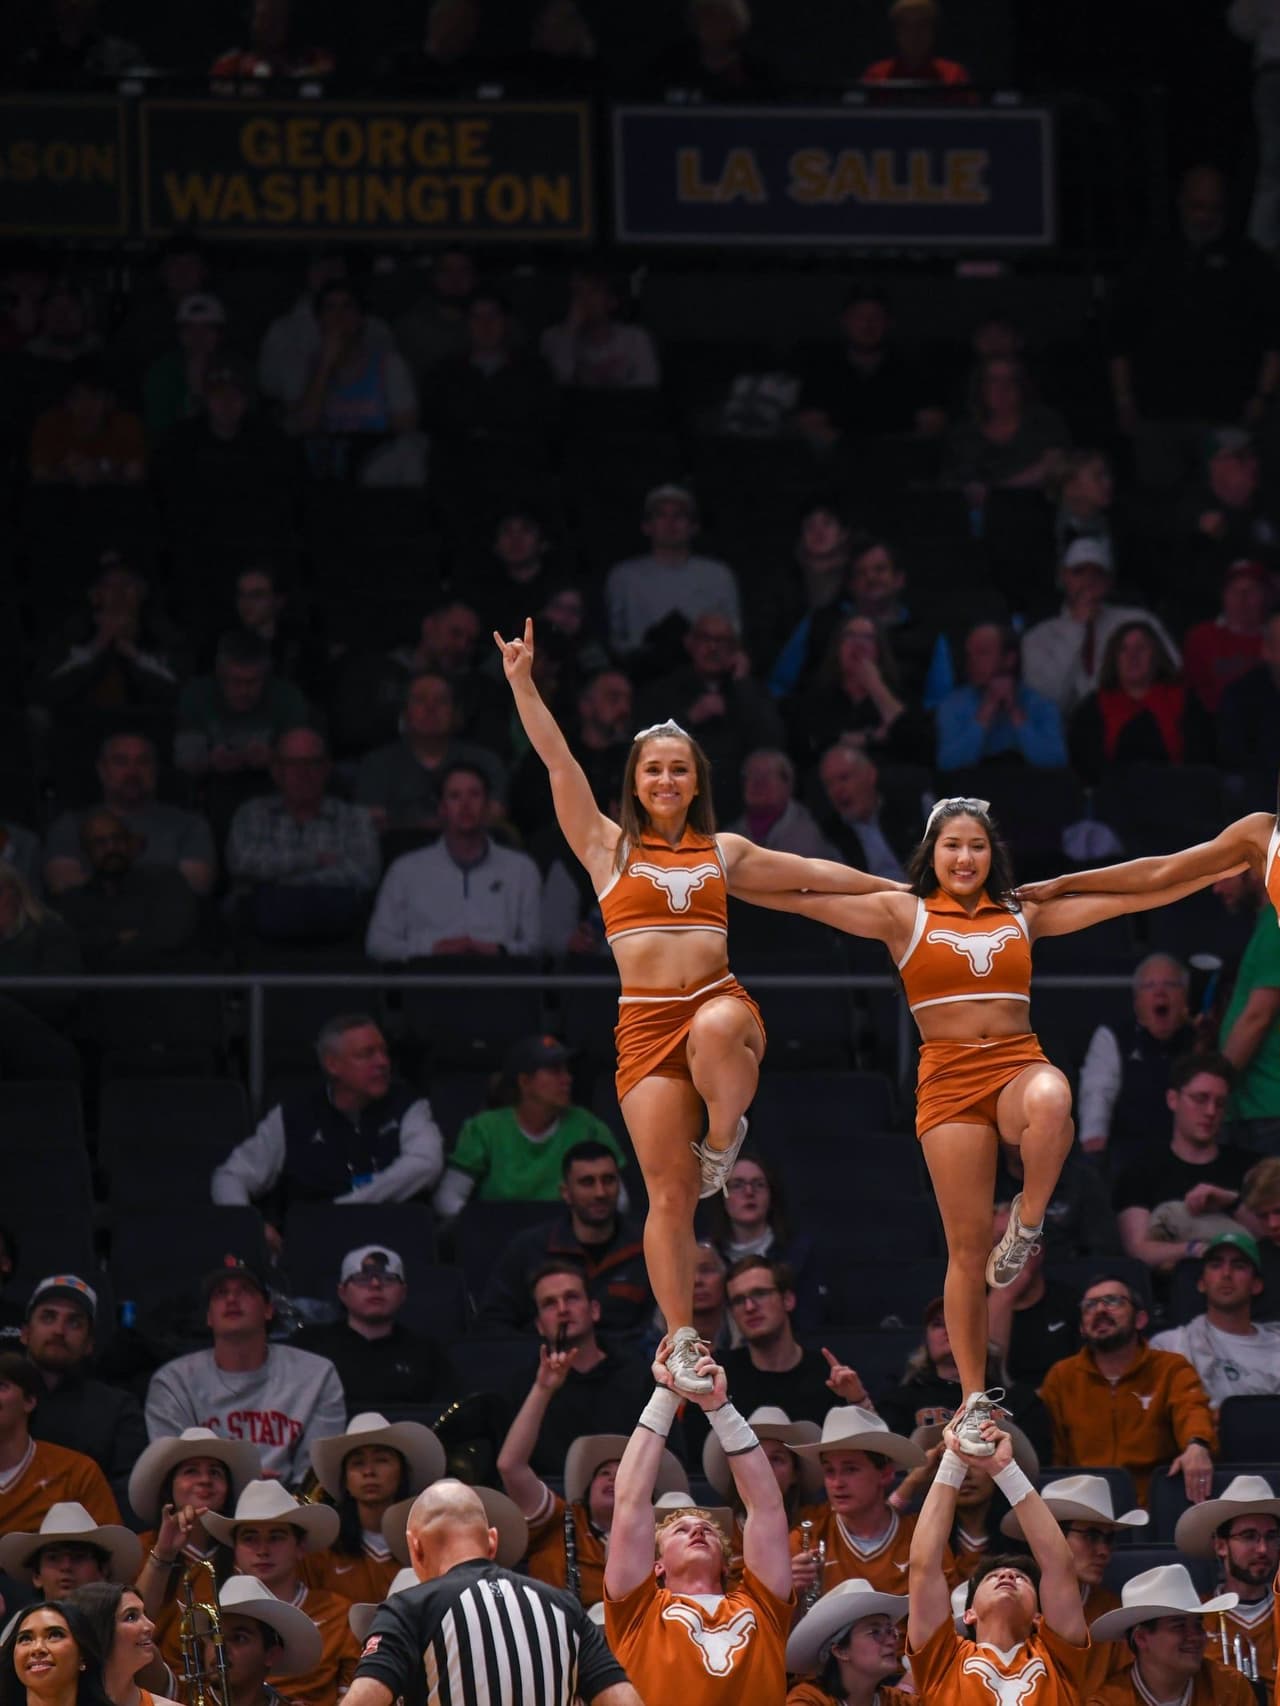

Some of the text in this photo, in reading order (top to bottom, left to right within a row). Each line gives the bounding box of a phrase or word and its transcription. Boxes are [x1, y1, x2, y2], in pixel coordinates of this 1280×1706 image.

[0, 141, 114, 183] SON
[238, 118, 493, 169] GEORGE
[163, 171, 572, 224] WASHINGTON
[676, 146, 991, 205] LA SALLE
